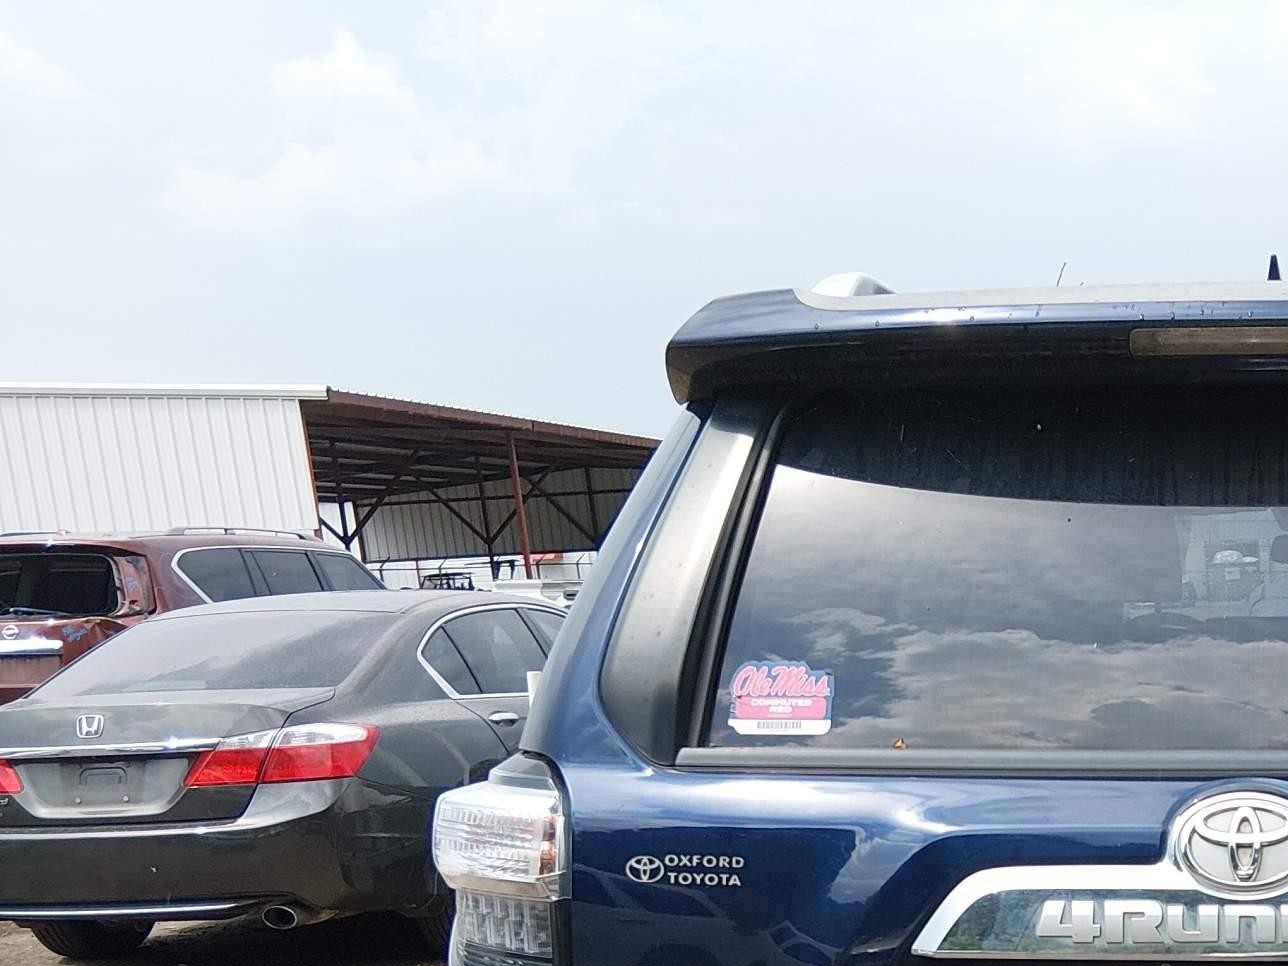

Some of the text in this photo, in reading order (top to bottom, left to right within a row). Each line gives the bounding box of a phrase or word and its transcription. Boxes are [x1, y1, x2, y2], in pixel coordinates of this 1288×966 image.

[733, 665, 830, 696] Ole Miss
[750, 698, 813, 707] COMMUTER
[664, 854, 744, 868] OXFORD
[667, 872, 741, 886] TOYOTA
